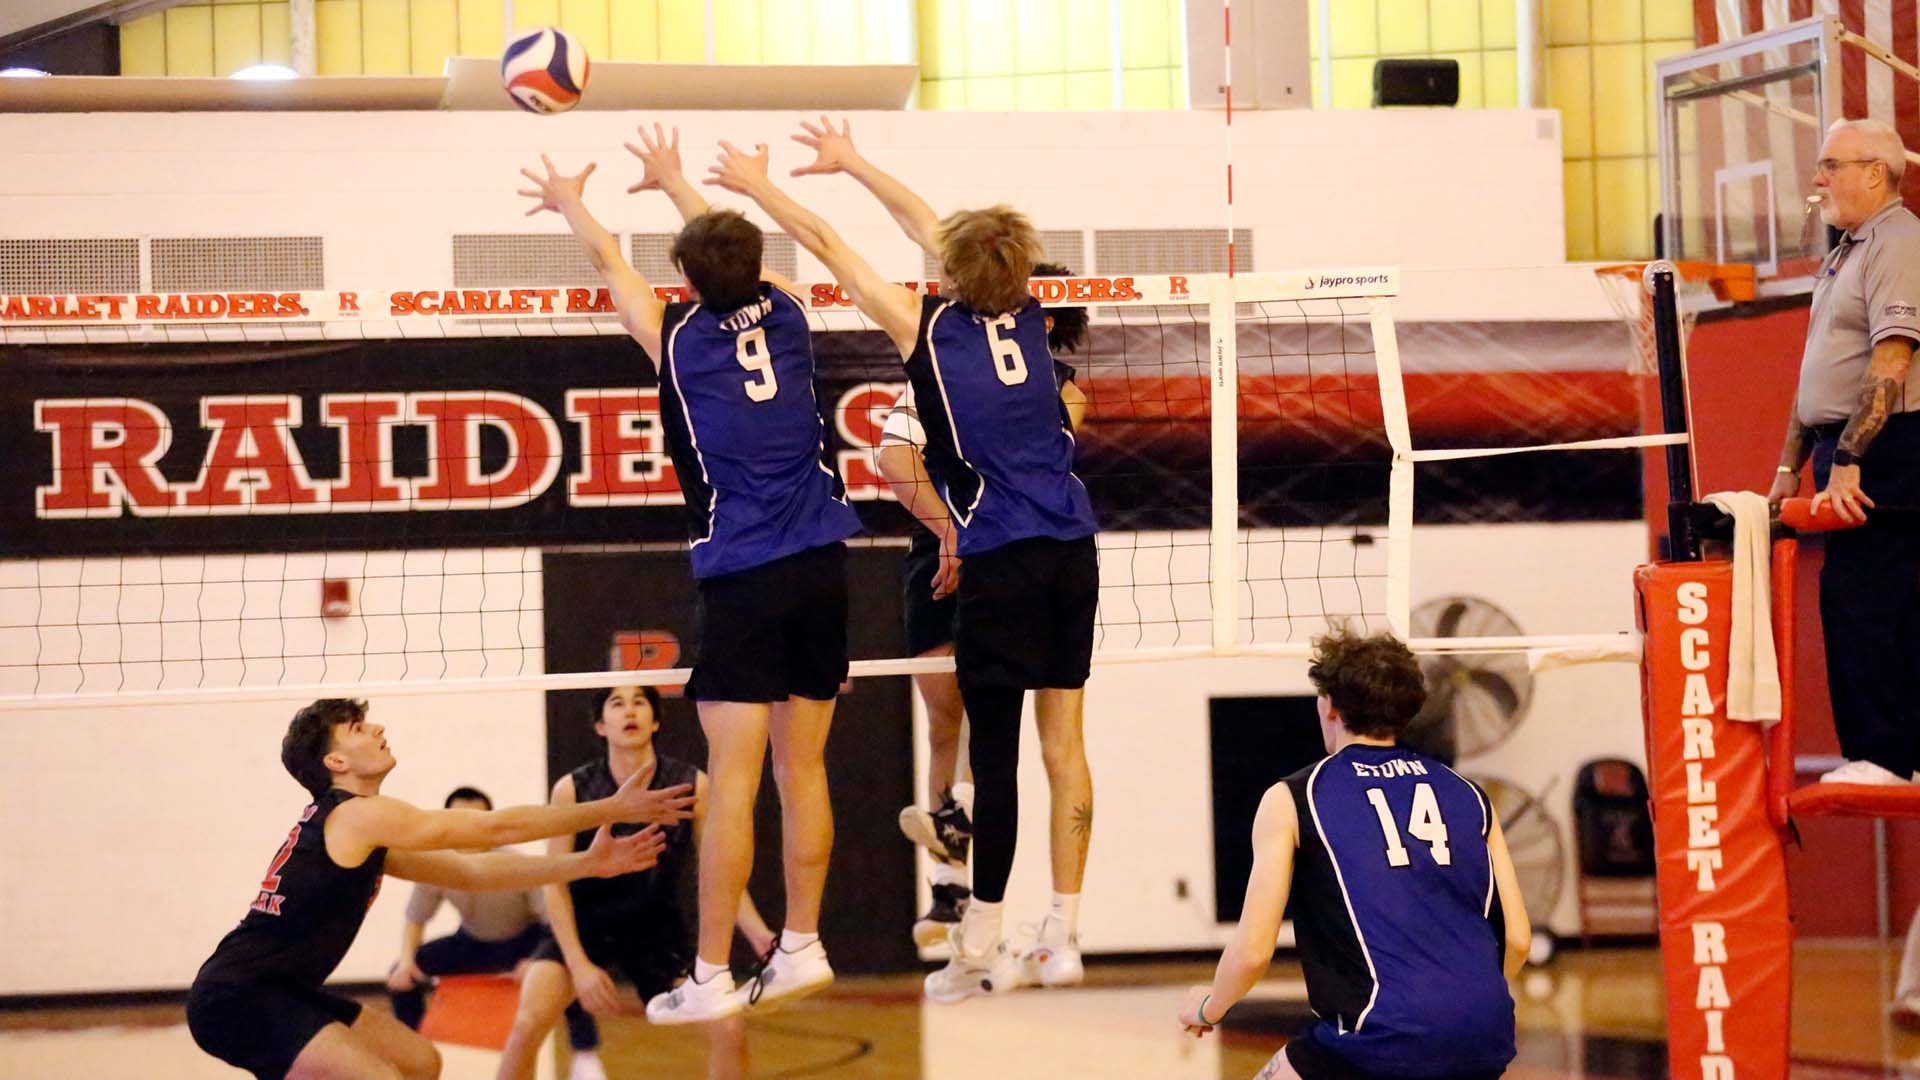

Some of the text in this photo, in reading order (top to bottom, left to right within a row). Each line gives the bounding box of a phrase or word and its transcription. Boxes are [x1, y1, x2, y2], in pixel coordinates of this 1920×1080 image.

[1027, 278, 1143, 301] IDERS.
[1169, 276, 1190, 295] R
[1319, 274, 1389, 288] jaypro sports
[0, 295, 128, 320] ARLET
[338, 291, 360, 311] R
[391, 289, 559, 316] SCARLET
[985, 313, 1029, 386] 6
[736, 327, 778, 402] 9
[33, 382, 905, 519] RAIDES
[1676, 581, 1723, 892] SCARLET
[1352, 759, 1428, 778] ETOWN
[1366, 783, 1451, 867] 14
